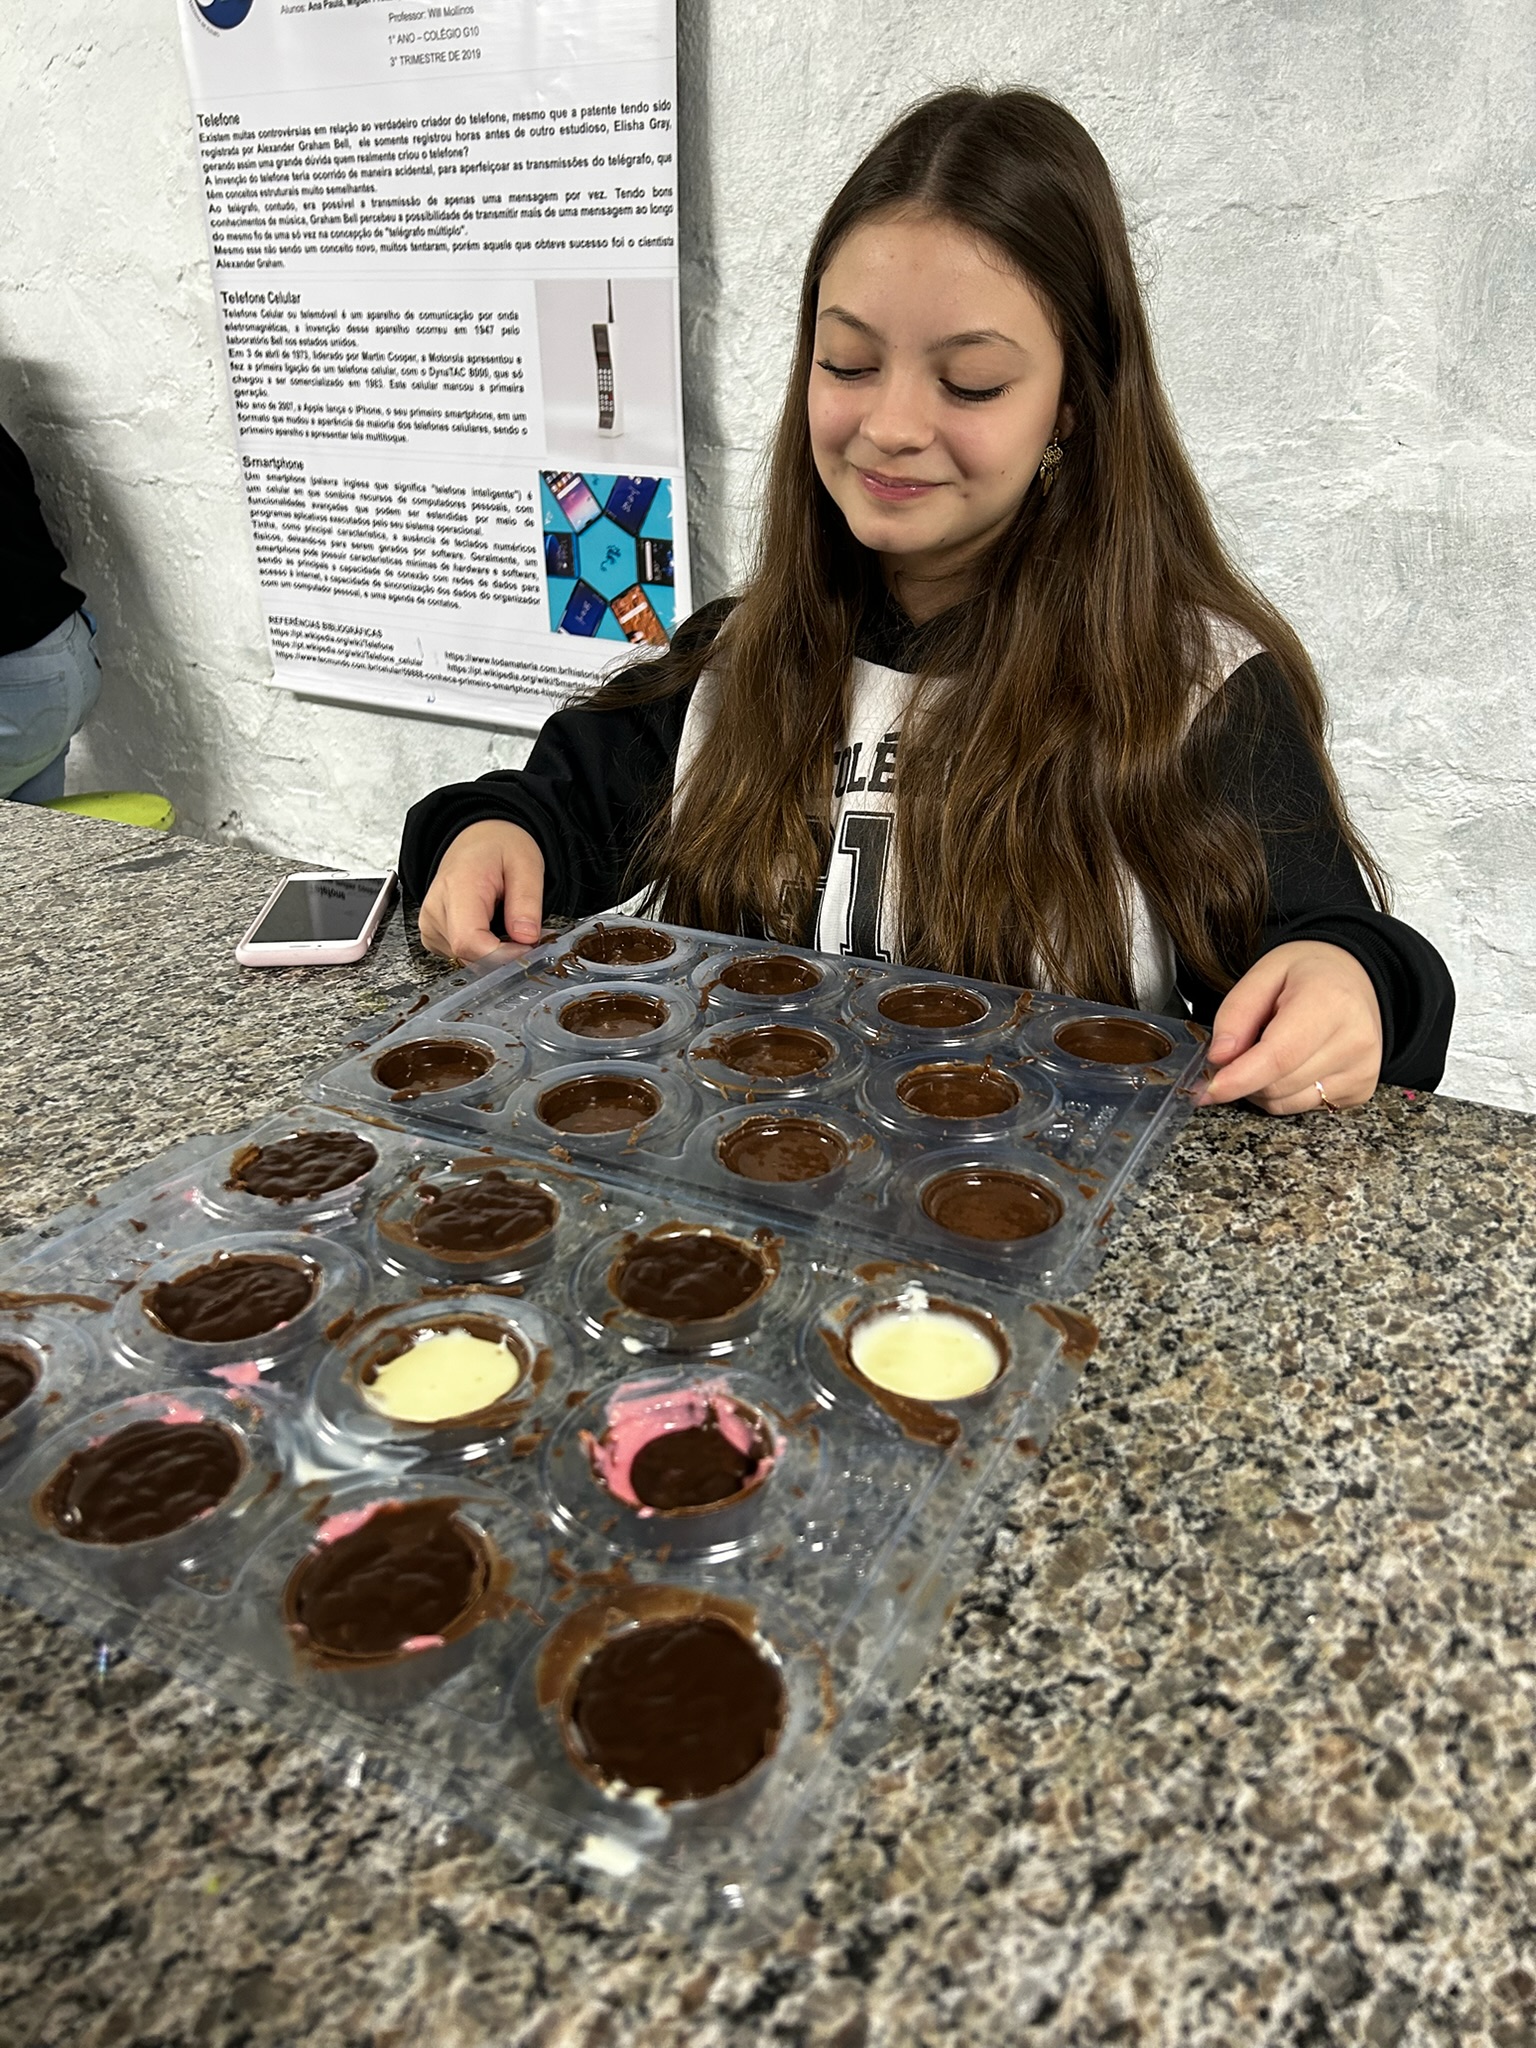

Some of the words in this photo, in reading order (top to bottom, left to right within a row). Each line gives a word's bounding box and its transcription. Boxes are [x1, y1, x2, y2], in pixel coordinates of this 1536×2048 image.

[197, 112, 240, 126] Telefone
[420, 116, 452, 127] criador
[454, 115, 467, 125] do
[512, 111, 546, 121] mesmo
[549, 109, 568, 121] que
[580, 104, 617, 119] patente
[620, 102, 649, 114] tendo
[652, 99, 672, 112] sido
[412, 132, 452, 146] registrou
[454, 131, 481, 141] horas
[484, 129, 511, 139] antes
[513, 127, 526, 138] de
[529, 126, 556, 136] outro
[613, 120, 645, 132] Elisha
[438, 165, 456, 176] para
[460, 161, 510, 174] aperfeiçoar
[513, 161, 523, 170] as
[526, 157, 588, 169] transmissões
[592, 155, 605, 166] do
[657, 154, 672, 165] que
[426, 195, 438, 206] de
[443, 196, 476, 206] apenas
[481, 194, 502, 204] uma
[507, 192, 559, 204] mensagem
[564, 191, 582, 202] por
[616, 187, 646, 198] Tendo
[651, 186, 673, 197] bons
[404, 210, 461, 222] possibilidade
[462, 209, 474, 220] de
[475, 208, 519, 219] transmitir
[519, 207, 542, 218] mais
[544, 206, 556, 217] de
[558, 207, 578, 217] uma
[579, 206, 633, 218] mensagem
[634, 205, 648, 214] ao
[649, 203, 674, 216] longo
[452, 240, 479, 252] porém
[483, 240, 511, 251] aquele
[515, 241, 531, 251] que
[534, 239, 565, 249] obteve
[569, 239, 608, 248] sucesso
[612, 236, 624, 247] foi
[638, 236, 674, 247] cientista
[220, 290, 265, 303] Telefone
[267, 291, 300, 303] Celular
[242, 455, 304, 470] Smartphone
[834, 732, 900, 798] OLÉ
